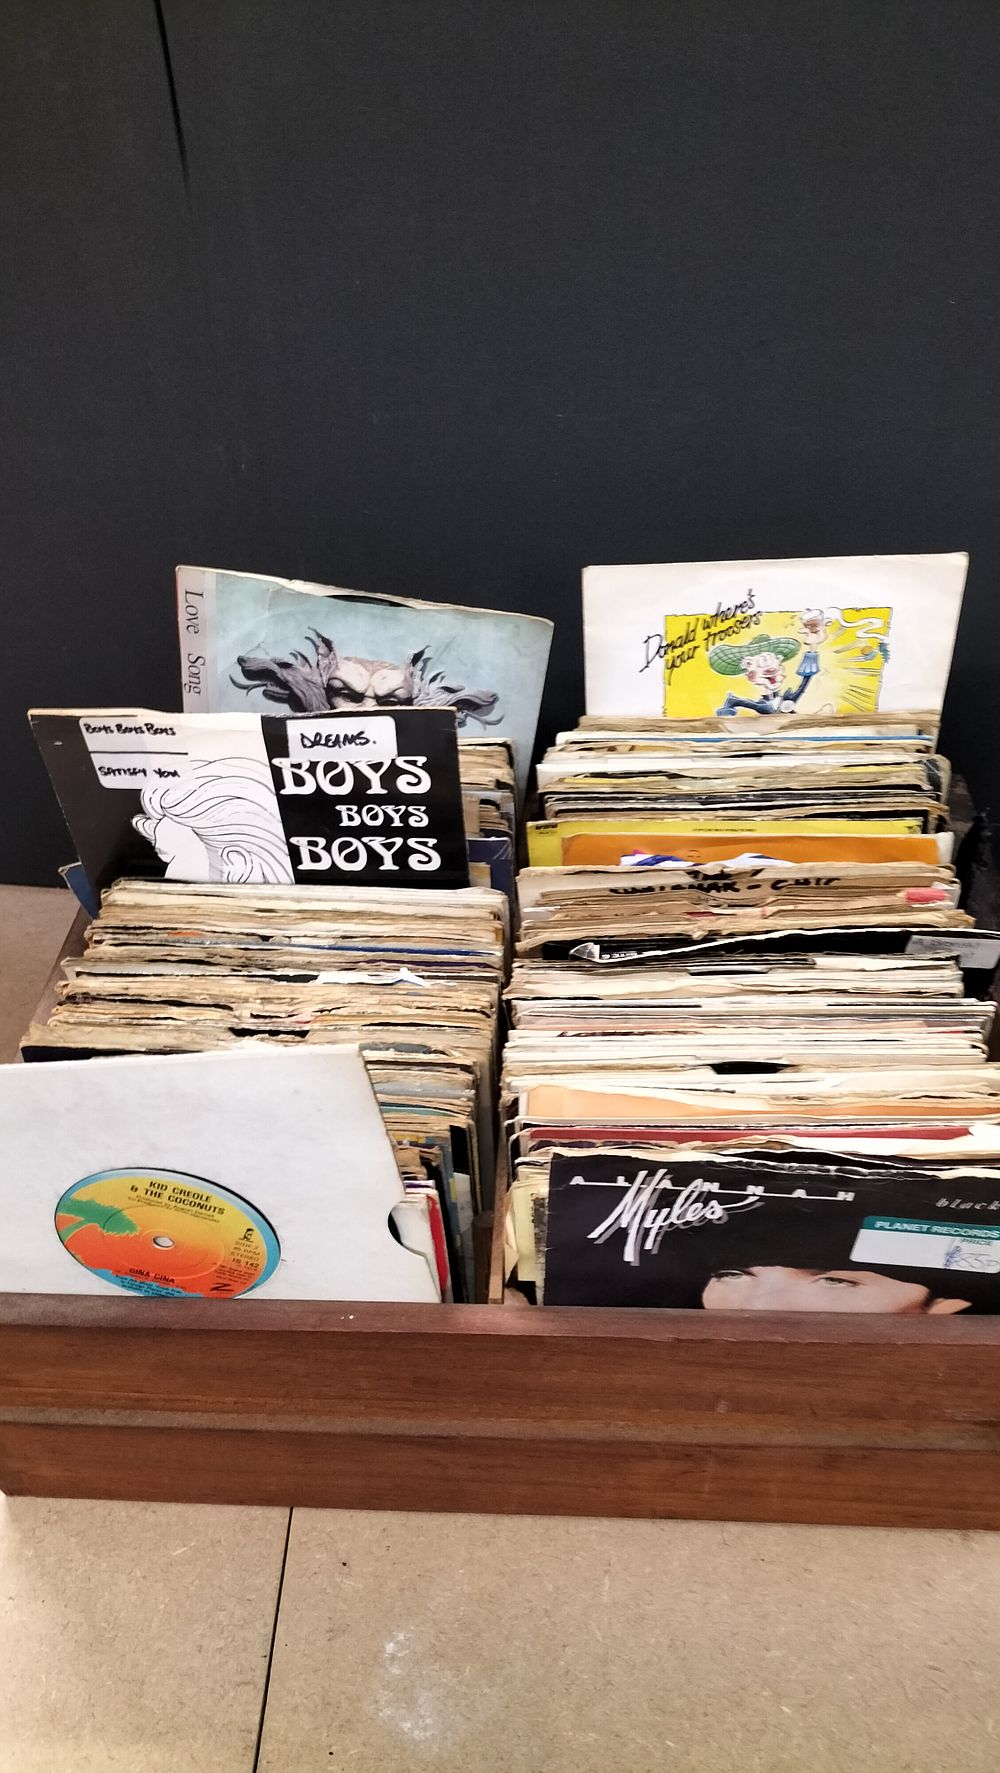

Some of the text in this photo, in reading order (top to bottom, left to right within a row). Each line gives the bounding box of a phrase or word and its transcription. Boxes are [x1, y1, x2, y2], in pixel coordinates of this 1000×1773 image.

[183, 588, 206, 696] Love Song
[638, 588, 756, 673] Donald where's
[665, 610, 763, 686] your troosers
[271, 755, 432, 796] BOYS
[334, 804, 430, 828] BOYS
[289, 836, 442, 872] BOYS
[144, 1187, 165, 1200] THE
[167, 1194, 226, 1215] COCONUTS
[148, 1180, 213, 1202] KID CREOLE
[935, 1198, 1000, 1211] black
[586, 1168, 764, 1266] Myles
[874, 1221, 1000, 1239] PLANET RECORDS
[129, 1267, 151, 1278] GINA
[153, 1272, 175, 1284] GINA
[245, 1260, 260, 1268] 142
